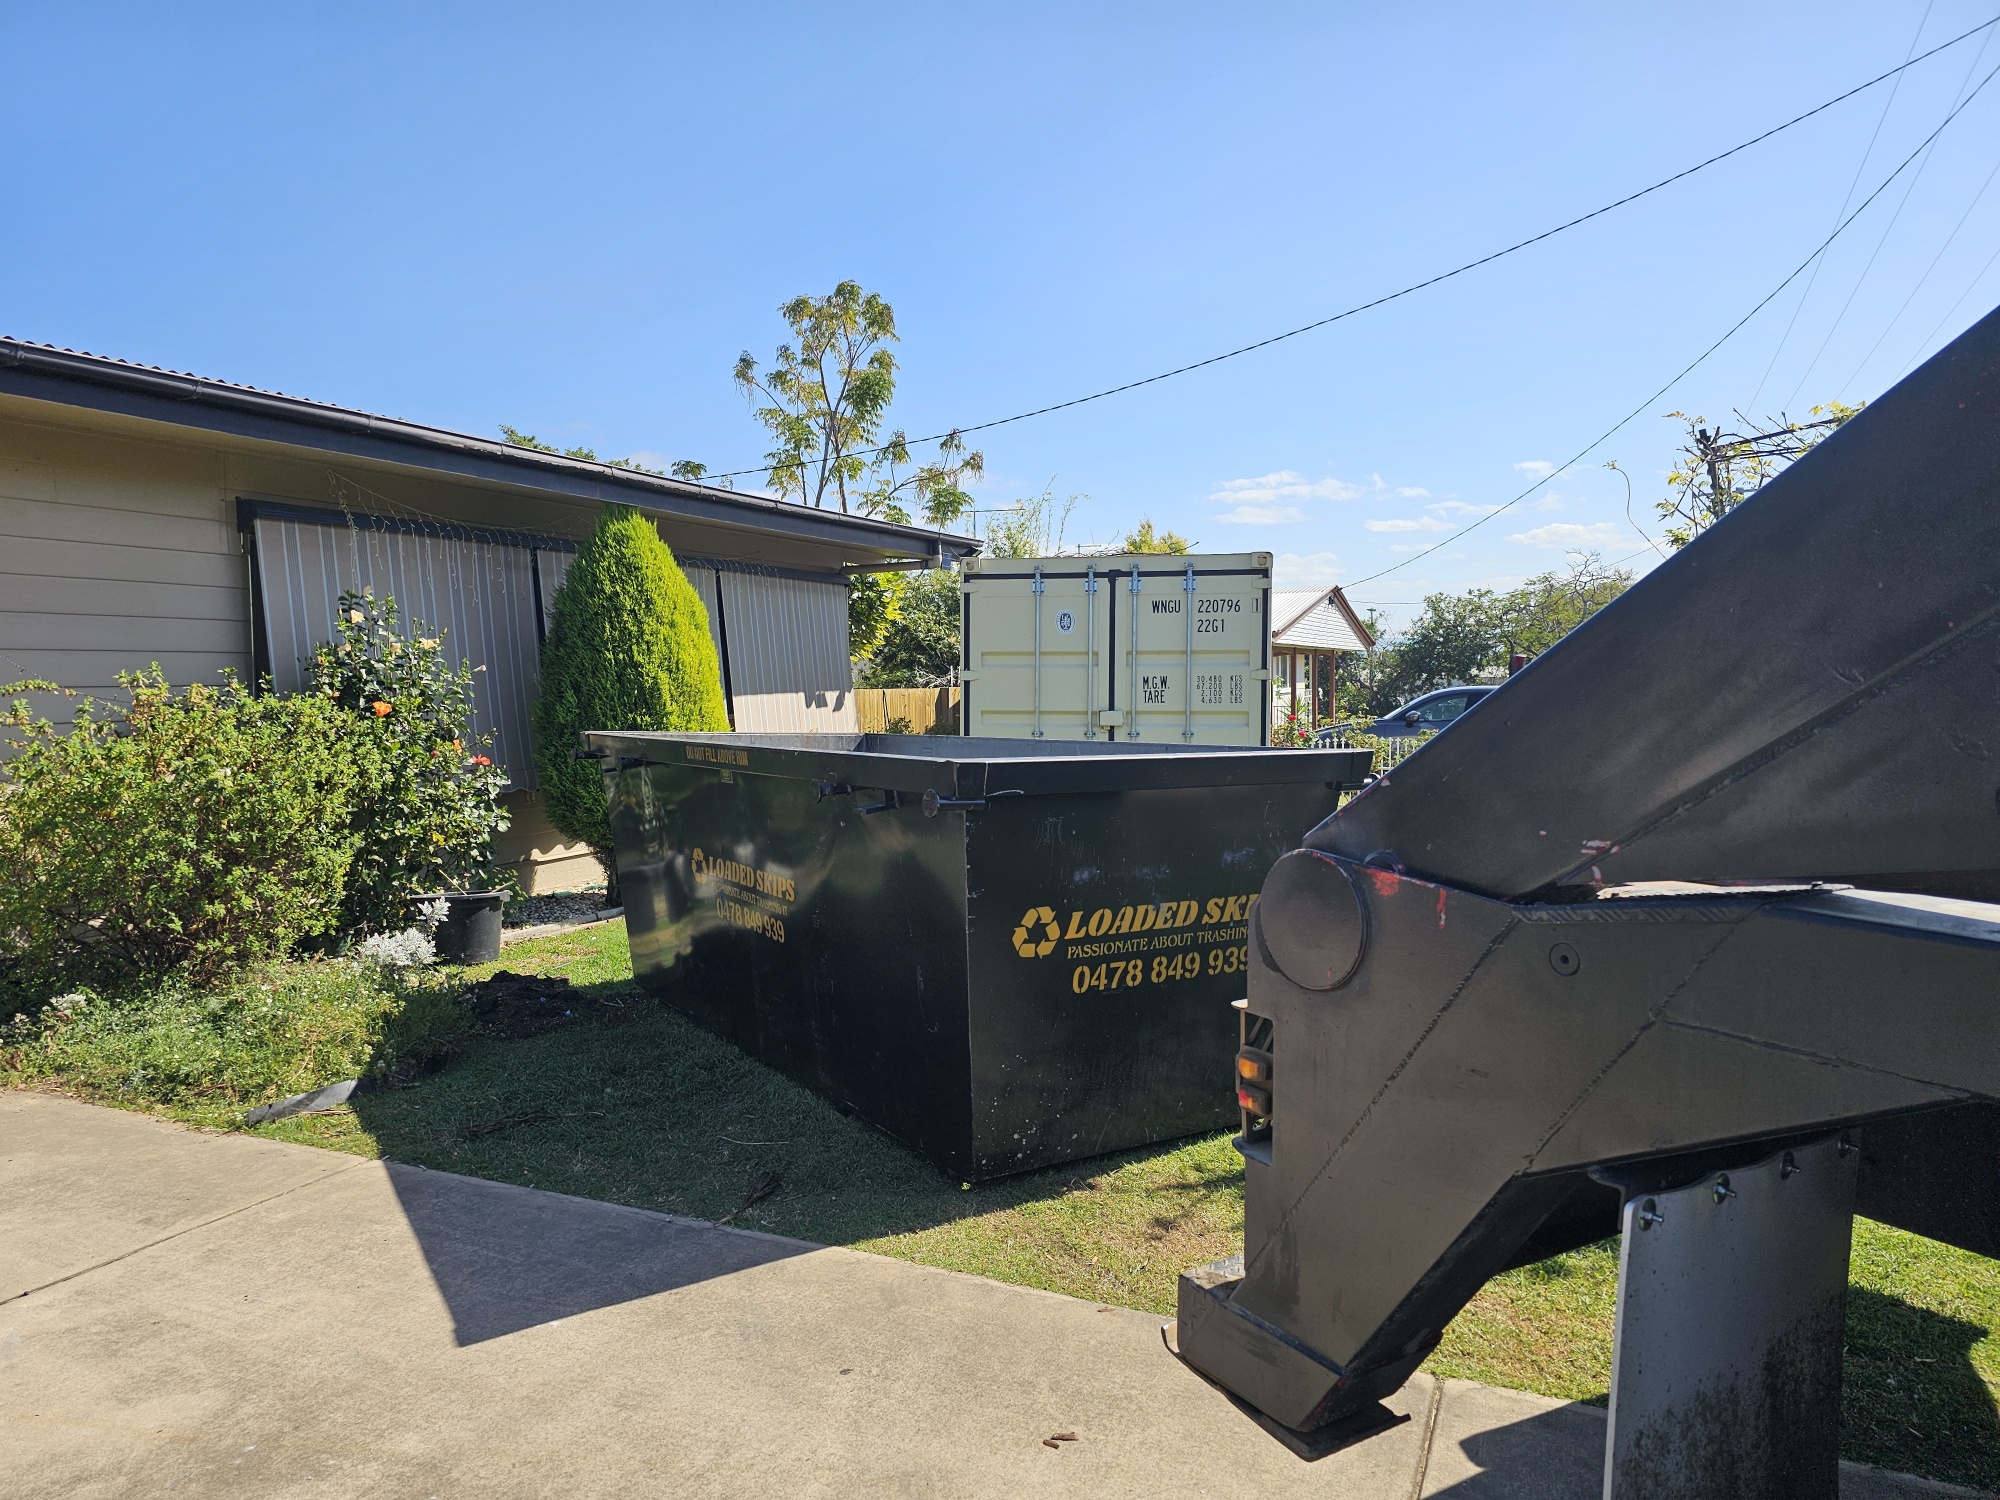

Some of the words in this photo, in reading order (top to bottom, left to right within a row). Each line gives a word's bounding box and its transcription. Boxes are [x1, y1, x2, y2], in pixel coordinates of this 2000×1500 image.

[1152, 599, 1181, 613] WNGU
[1197, 599, 1241, 613] 220796
[1197, 619, 1225, 633] 22G1
[1142, 675, 1170, 690] M.G.W.
[1230, 675, 1243, 683] KGS
[1230, 682, 1243, 690] LBS
[1143, 690, 1166, 704] TARE
[1230, 689, 1243, 697] KGS
[1230, 696, 1243, 704] LBS
[685, 745, 694, 759] DO
[694, 747, 705, 761] NOT
[705, 747, 717, 763] FILL
[717, 749, 736, 765] ABOVE
[736, 750, 749, 767] RIM
[708, 856, 755, 888] LOADED
[756, 869, 795, 902] SKIPS
[741, 890, 756, 905] ABOUT
[716, 897, 743, 926] 0478
[744, 906, 763, 934] 849
[764, 917, 785, 944] 939
[1064, 900, 1199, 940] LOADED
[1067, 938, 1148, 960] PASSIONATE
[1150, 932, 1194, 950] ABOUT
[1197, 926, 1249, 944] TRASHIN
[1072, 958, 1144, 994] 0478
[1151, 951, 1201, 984] 849
